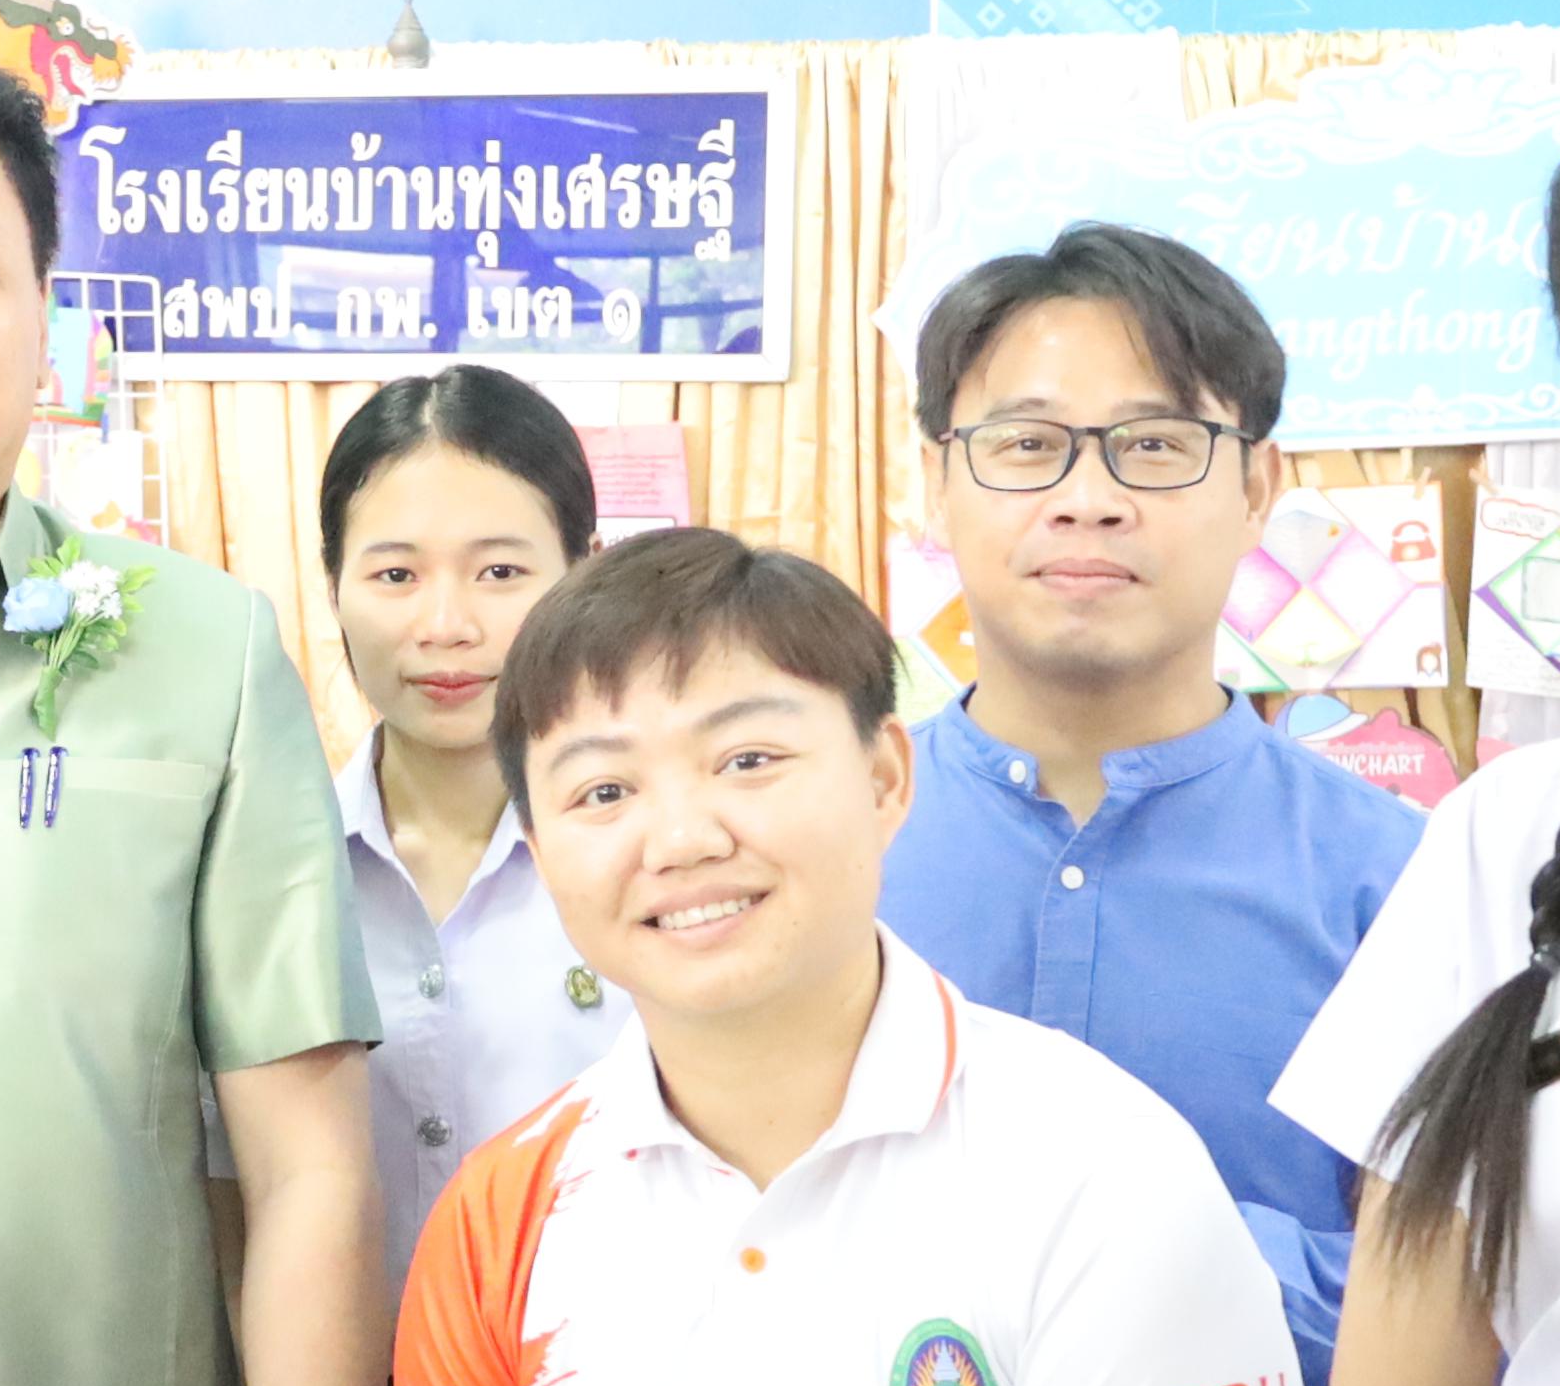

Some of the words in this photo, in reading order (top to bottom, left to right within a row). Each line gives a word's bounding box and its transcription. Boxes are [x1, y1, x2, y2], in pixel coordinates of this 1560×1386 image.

[78, 120, 736, 268] โรงเรียนบ้านทุ่งเศรษฐี
[162, 277, 308, 340] สพป.
[335, 281, 438, 339] กพ.
[467, 281, 572, 339] เขต
[602, 283, 641, 343] ๑
[1274, 288, 1541, 382] angthong
